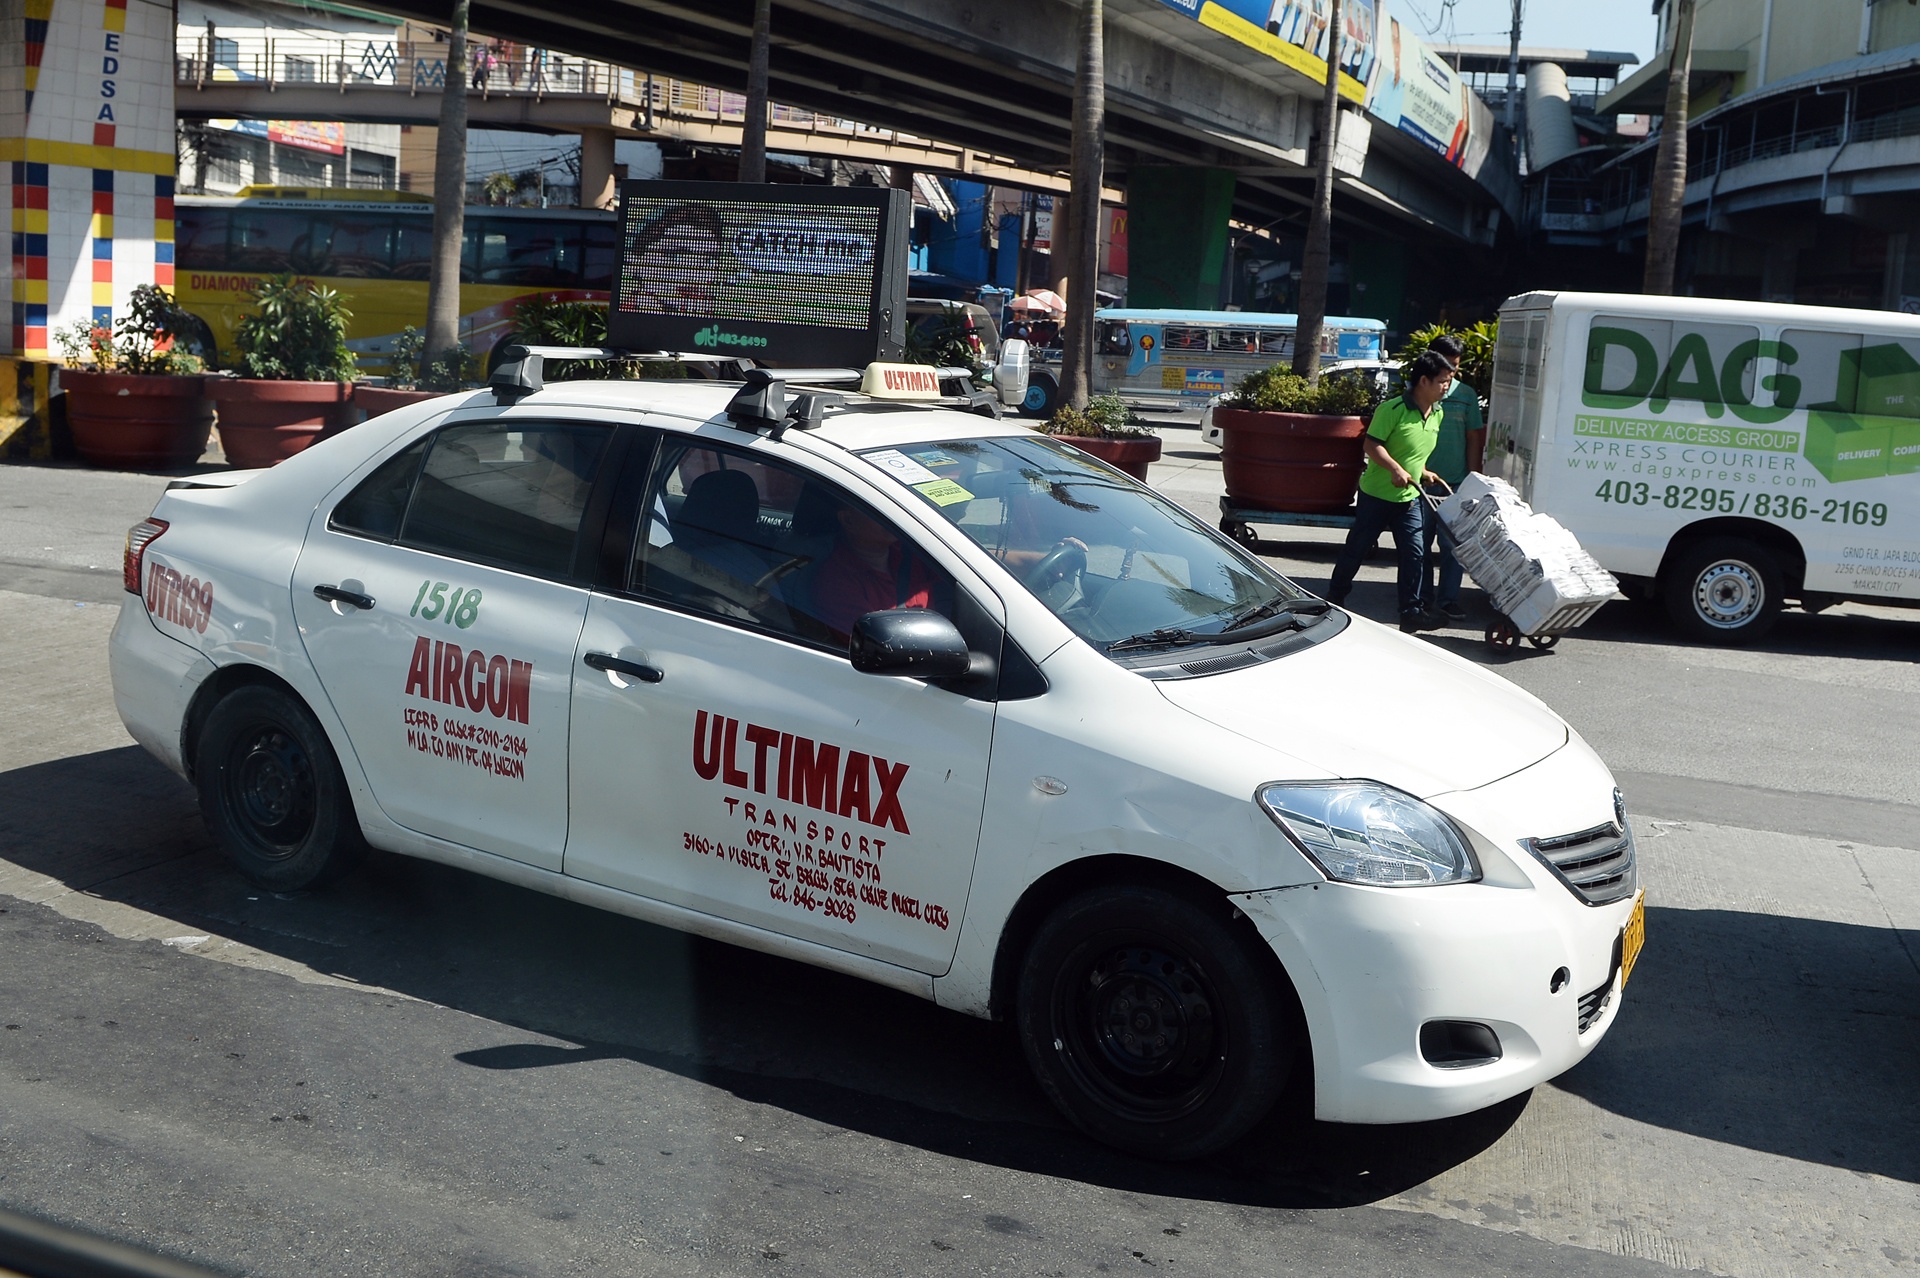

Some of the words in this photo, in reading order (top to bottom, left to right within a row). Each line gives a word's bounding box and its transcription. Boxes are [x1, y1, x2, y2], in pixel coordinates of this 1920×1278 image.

[97, 33, 120, 122] EDSA
[734, 229, 818, 254] CATCH
[883, 369, 939, 392] ULTIMAX
[1582, 326, 1802, 424] DAG
[1885, 395, 1904, 406] THE
[1576, 418, 1659, 438] DELIVERY
[1663, 424, 1731, 444] ACCESS
[1735, 431, 1797, 450] GROUP
[1573, 440, 1667, 461] XPRESS
[1682, 449, 1795, 472] COURIER
[1838, 449, 1881, 461] DELIVERY
[1567, 457, 1816, 488] www.dagxpress.com
[1842, 547, 1864, 559] GRND
[1883, 550, 1901, 561] JAPA
[1835, 563, 1855, 574] 2256
[1856, 564, 1881, 576] CHINO
[1882, 566, 1908, 578] ROCES
[1885, 581, 1903, 592] CITY
[409, 580, 483, 629] 1518
[405, 635, 533, 725] AIRCON
[446, 741, 463, 765] ANY
[693, 709, 911, 836] ULTIMAX
[723, 796, 886, 862] TRANSPORT
[818, 849, 880, 884] BAUTISTA
[793, 887, 857, 923] 846-9028
